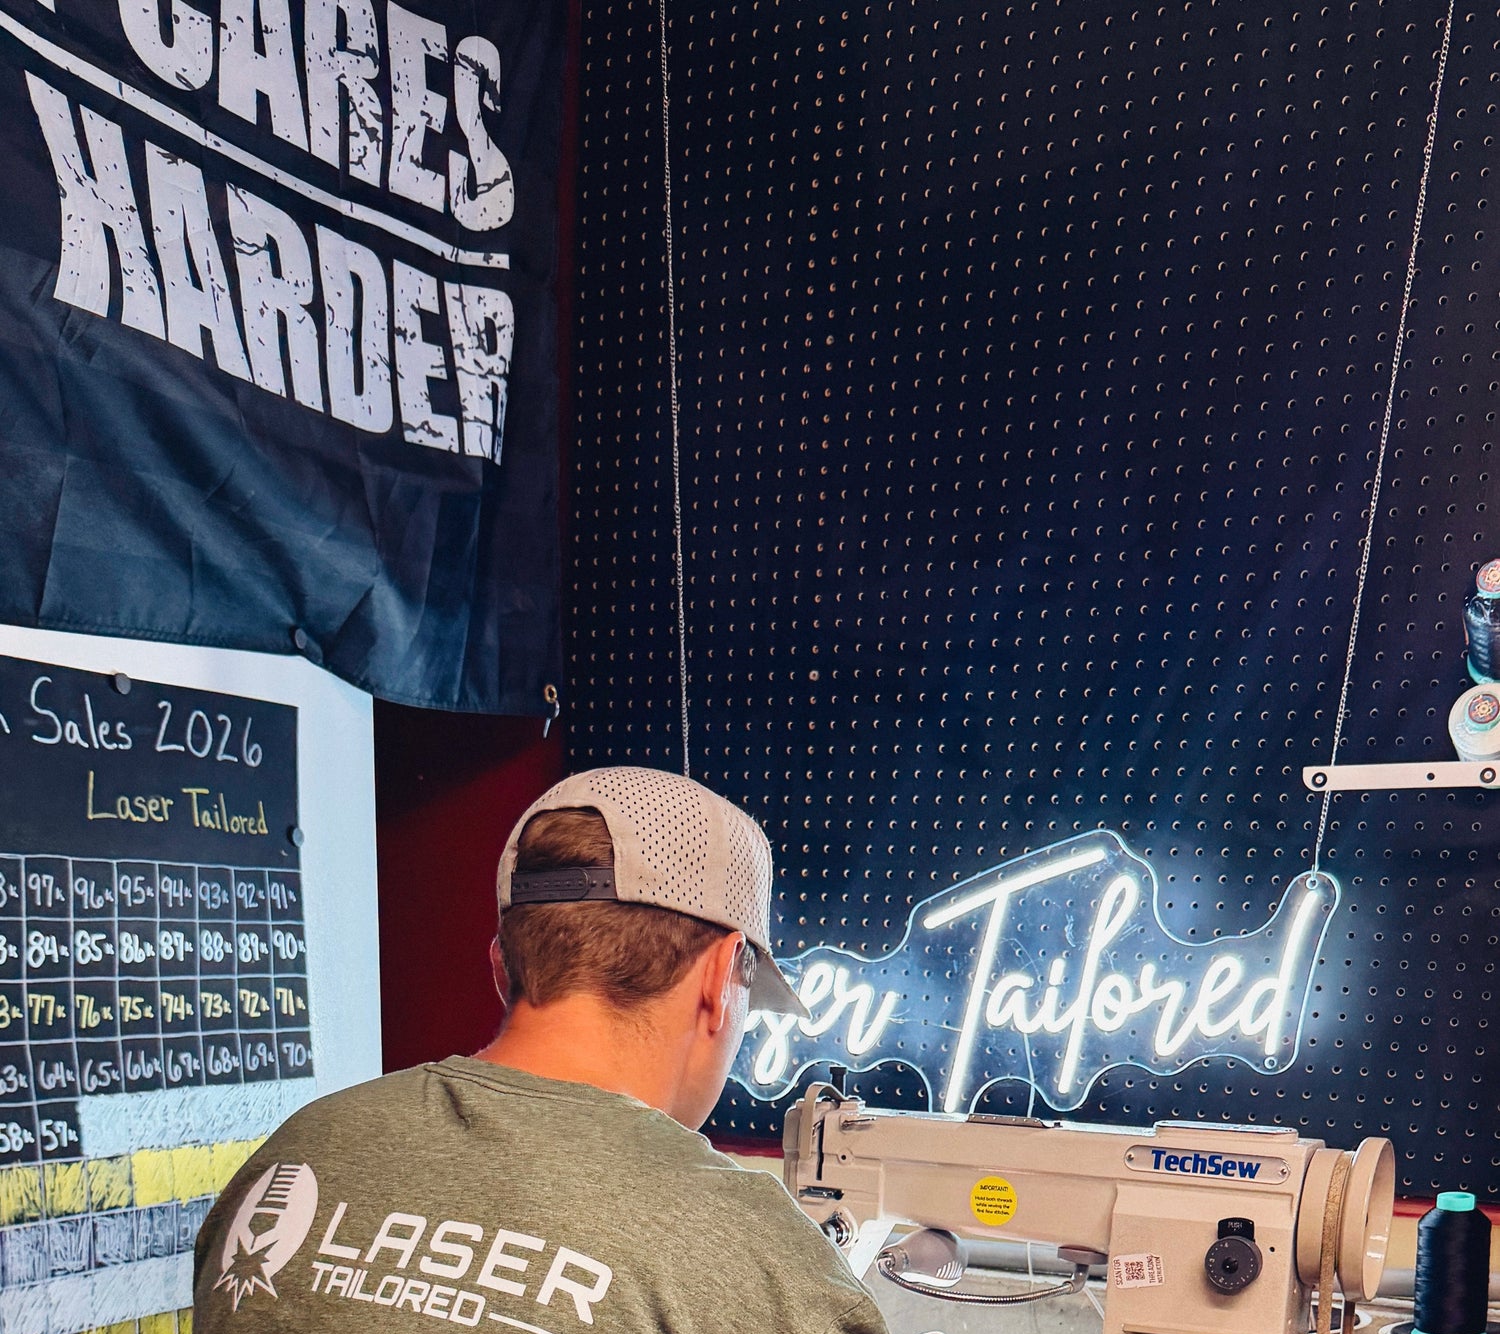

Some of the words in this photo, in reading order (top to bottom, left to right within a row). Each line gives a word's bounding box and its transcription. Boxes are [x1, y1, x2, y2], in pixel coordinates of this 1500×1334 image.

[24, 70, 515, 466] HARDER
[31, 676, 133, 750] Sales
[155, 700, 263, 767] 2026
[87, 770, 174, 822] Laser
[181, 787, 269, 835] Tailored
[923, 849, 1320, 1113] Tailored
[1151, 1149, 1261, 1179] TechSew
[311, 1261, 486, 1327] TAILORED
[318, 1201, 613, 1325] LASER
